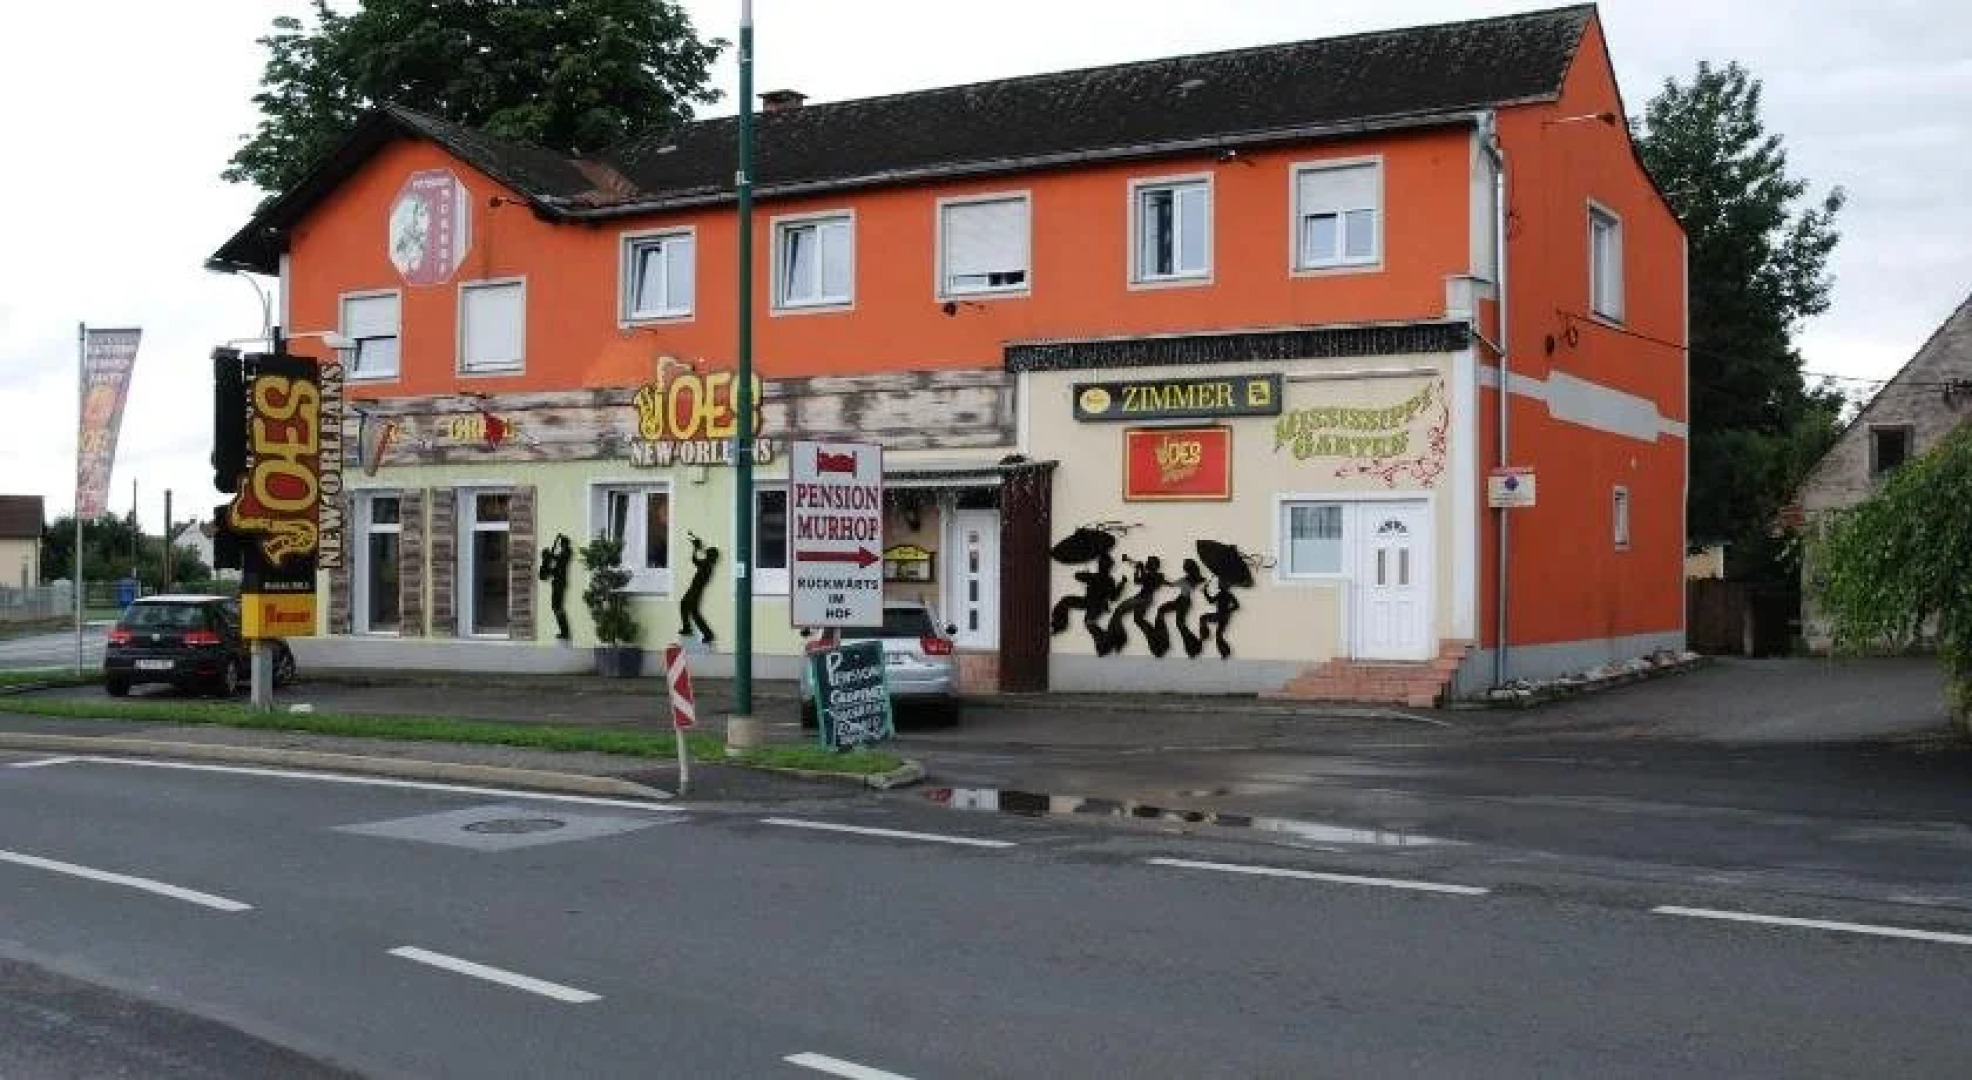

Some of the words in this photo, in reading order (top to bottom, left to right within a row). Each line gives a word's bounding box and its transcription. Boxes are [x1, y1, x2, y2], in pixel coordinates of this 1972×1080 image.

[1121, 383, 1235, 412] ZIMMER
[319, 364, 342, 494] ORLEANS
[631, 442, 672, 467] NEW
[796, 483, 879, 510] PENSION
[319, 506, 342, 568] NEW
[828, 593, 844, 604] IM
[826, 608, 852, 619] HOF
